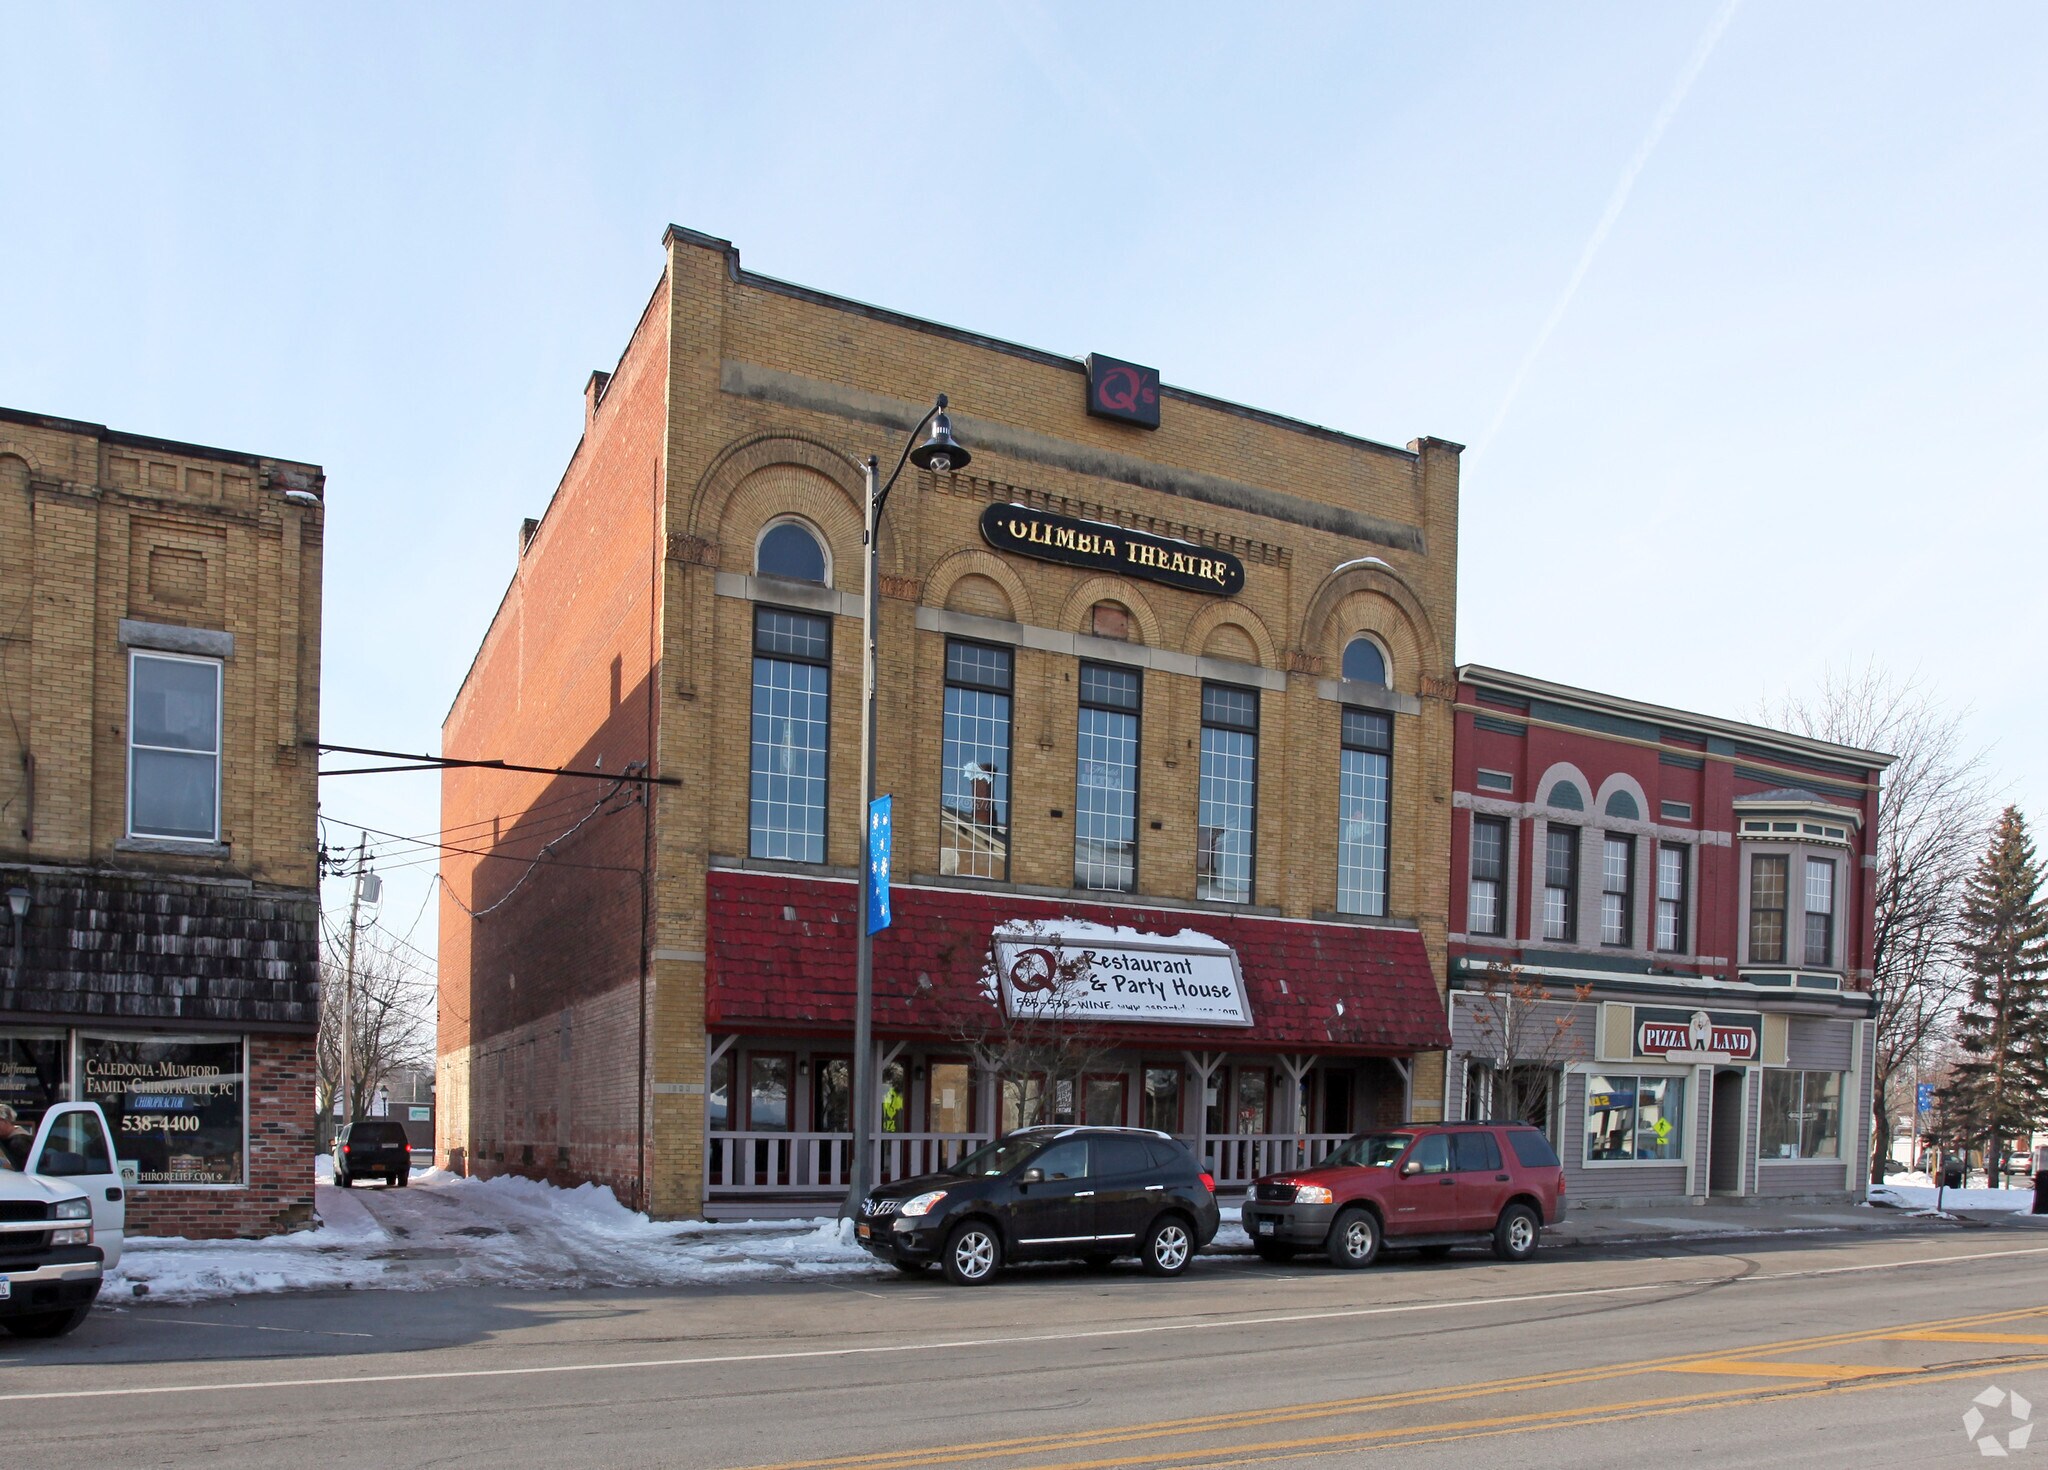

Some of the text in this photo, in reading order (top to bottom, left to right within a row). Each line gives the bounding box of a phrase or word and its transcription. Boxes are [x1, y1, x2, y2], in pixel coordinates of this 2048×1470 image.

[1099, 366, 1156, 413] Q's
[1008, 519, 1227, 586] OLIMBIA THEATRE
[1082, 950, 1193, 975] Restaurant
[1090, 974, 1232, 1002] & Party House
[1645, 1029, 1749, 1050] PIZZA LAND
[86, 1077, 129, 1093] FAMILY
[134, 1096, 185, 1108] CHIROPRACTOR
[121, 1115, 200, 1132] 538-4400
